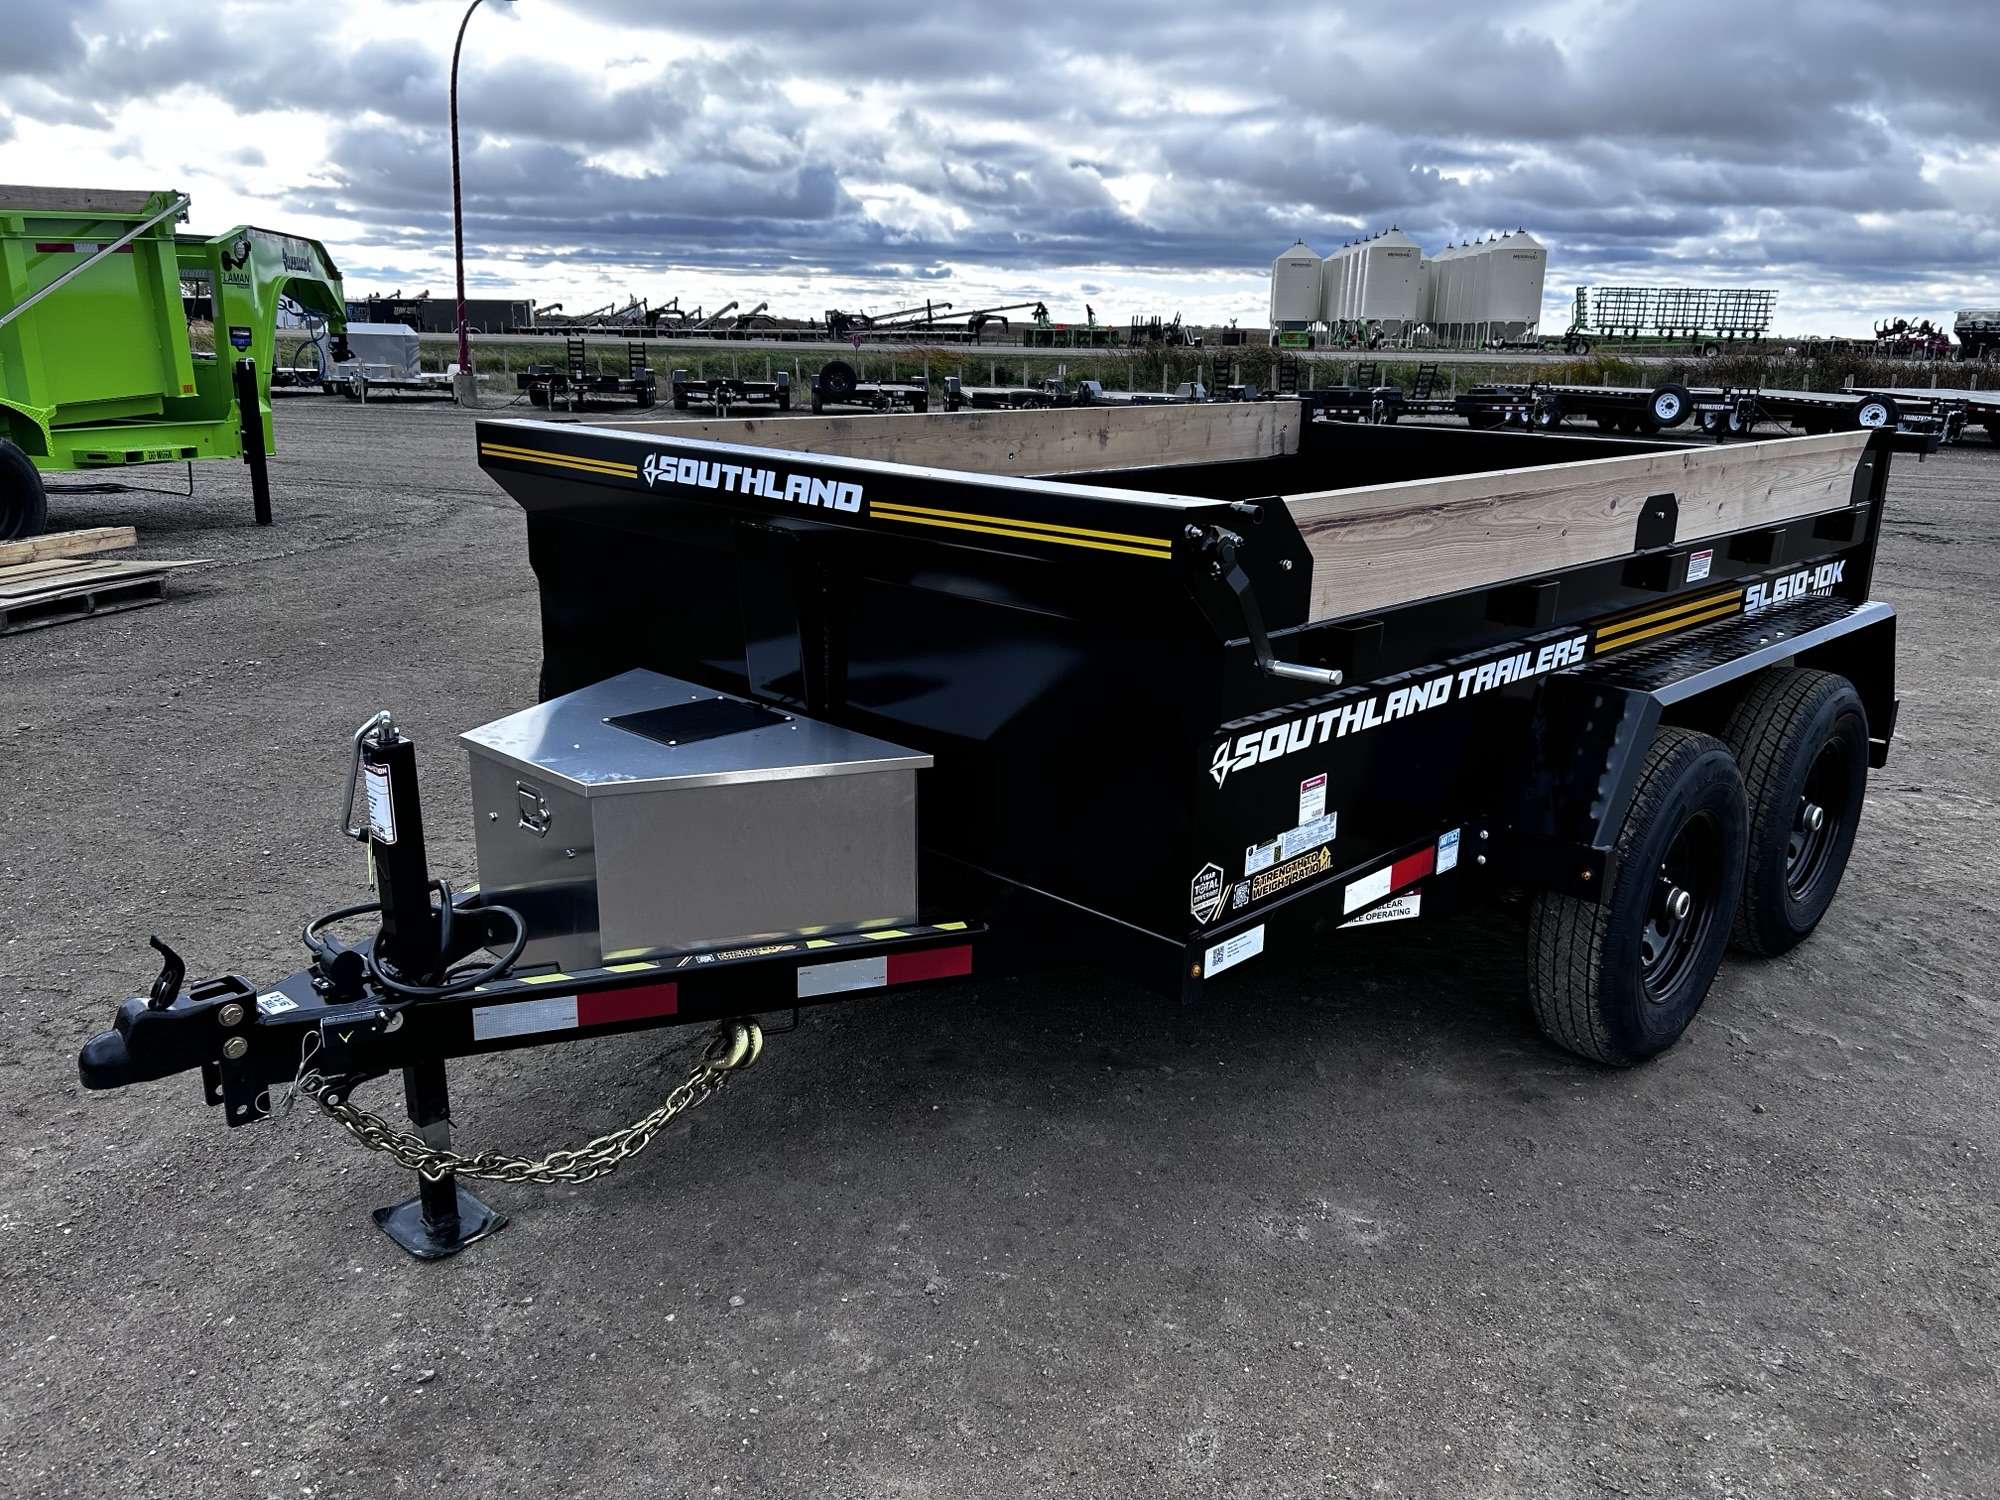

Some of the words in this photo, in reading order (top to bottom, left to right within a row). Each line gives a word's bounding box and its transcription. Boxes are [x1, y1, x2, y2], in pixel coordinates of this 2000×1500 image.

[657, 455, 864, 514] SOUTHLAND
[1743, 559, 1847, 613] SL610-10K
[1232, 674, 1454, 773] SOUTHLAND
[1457, 634, 1589, 700] TRAILERS
[1194, 878, 1219, 896] TOTAL
[1252, 874, 1290, 900] WEIGHT
[1291, 861, 1320, 883] RATIO
[1365, 907, 1411, 921] OPERATING
